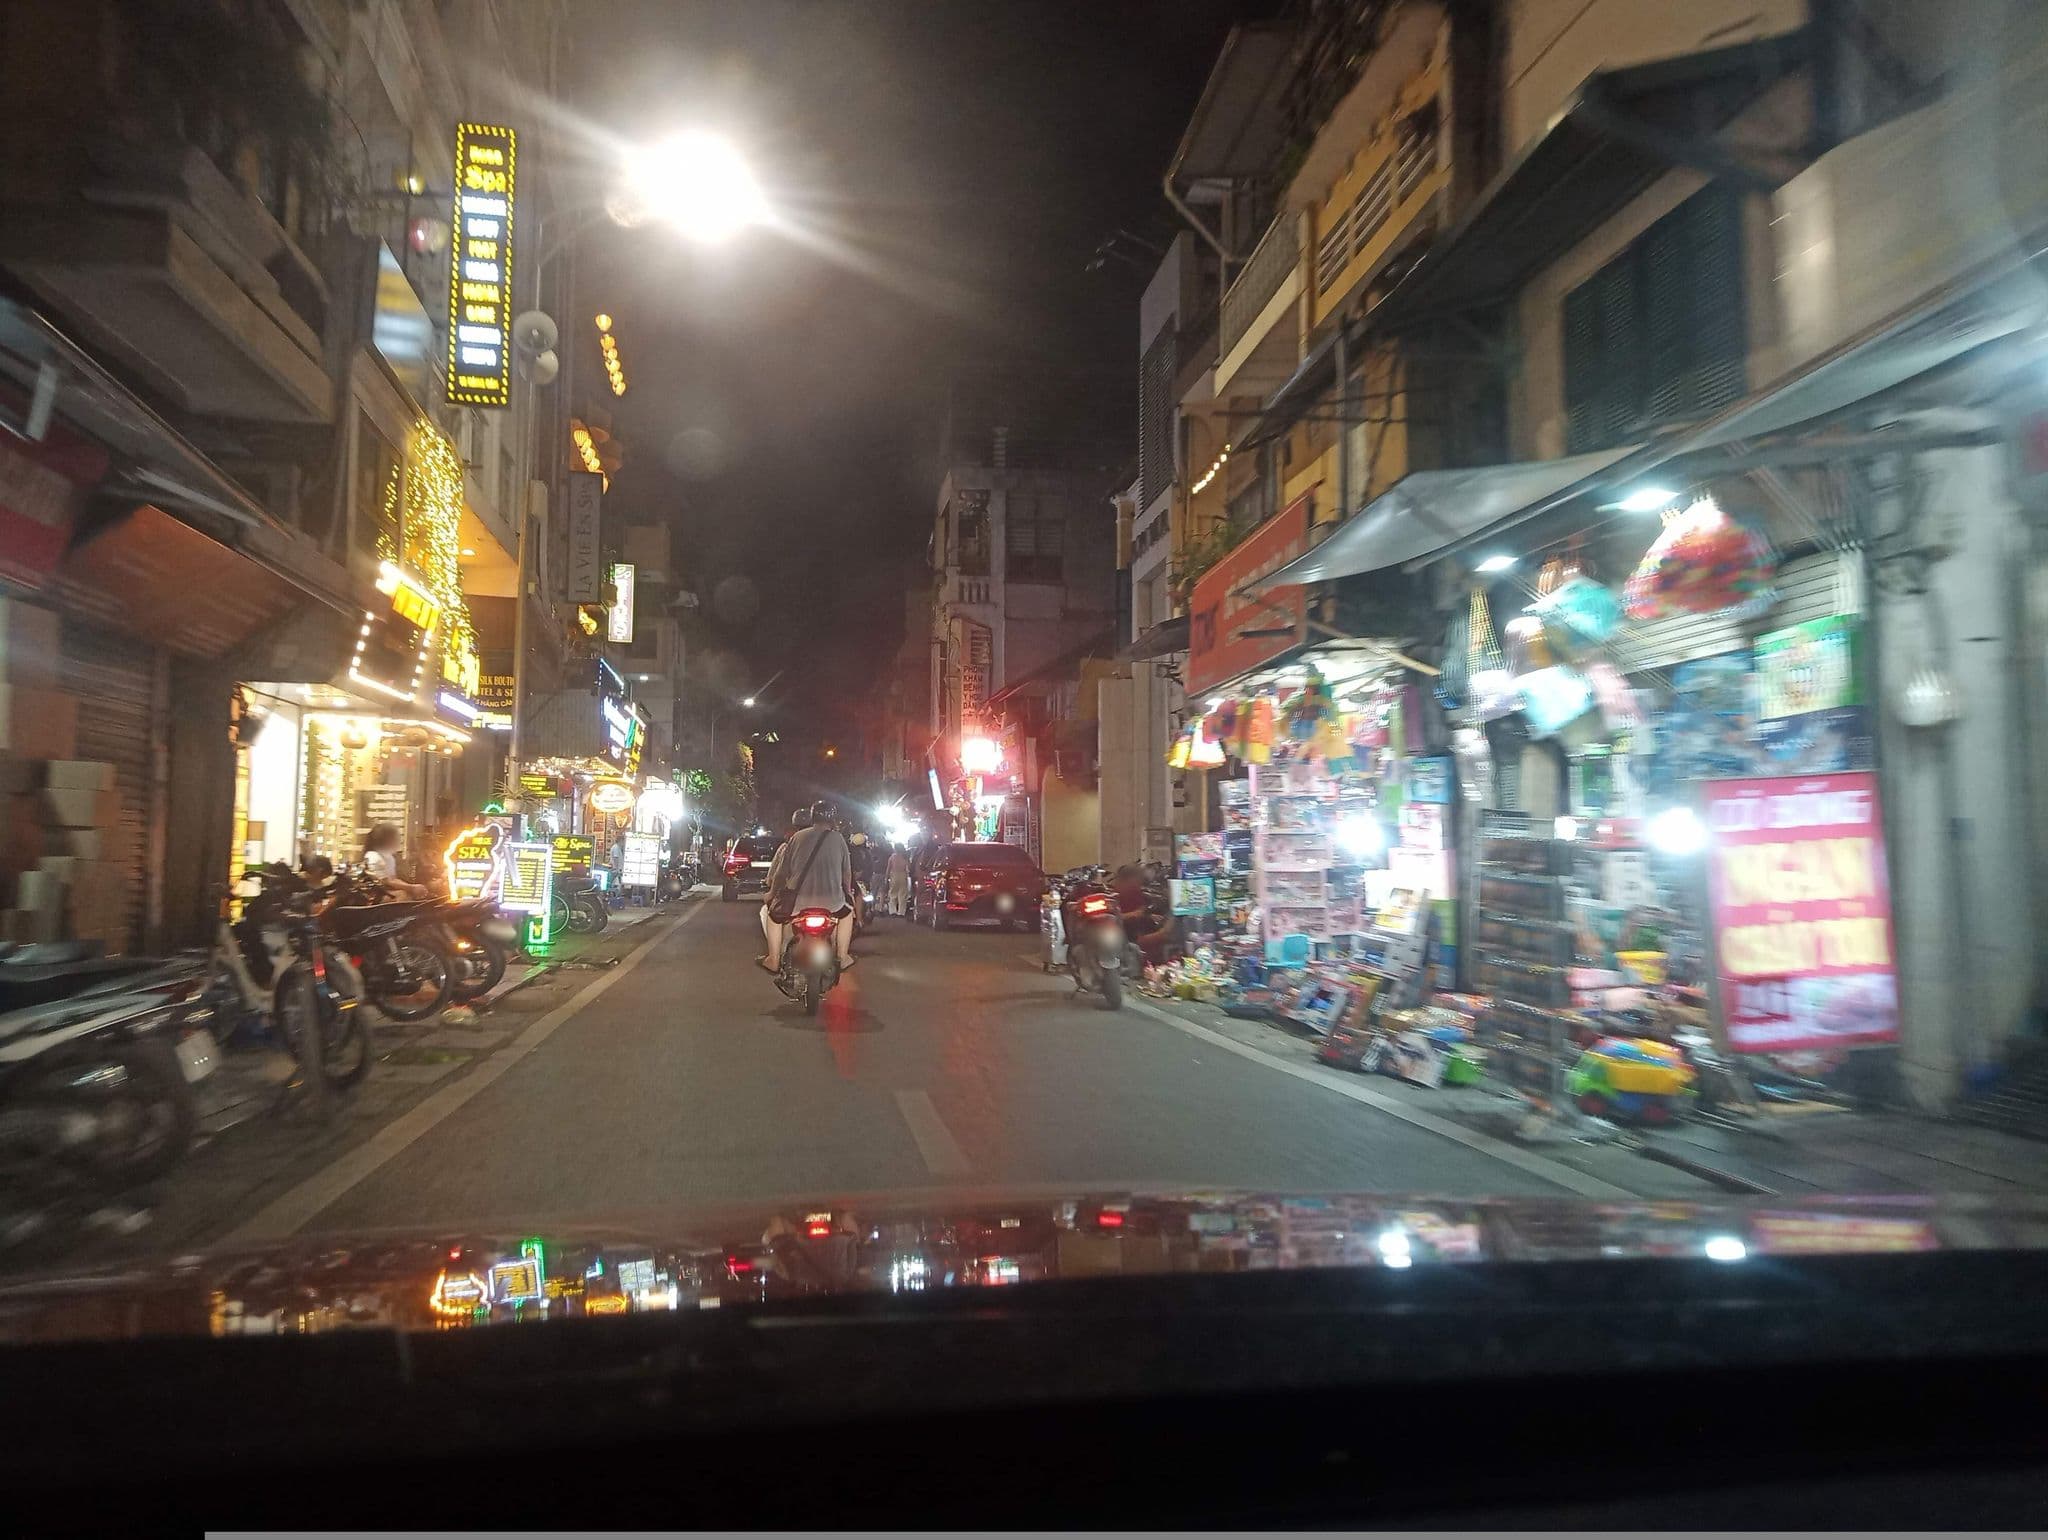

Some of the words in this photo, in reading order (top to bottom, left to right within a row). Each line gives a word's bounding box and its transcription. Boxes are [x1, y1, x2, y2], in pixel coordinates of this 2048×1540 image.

[465, 165, 506, 193] Spa
[569, 837, 593, 851] Spa
[457, 845, 491, 860] SPA
